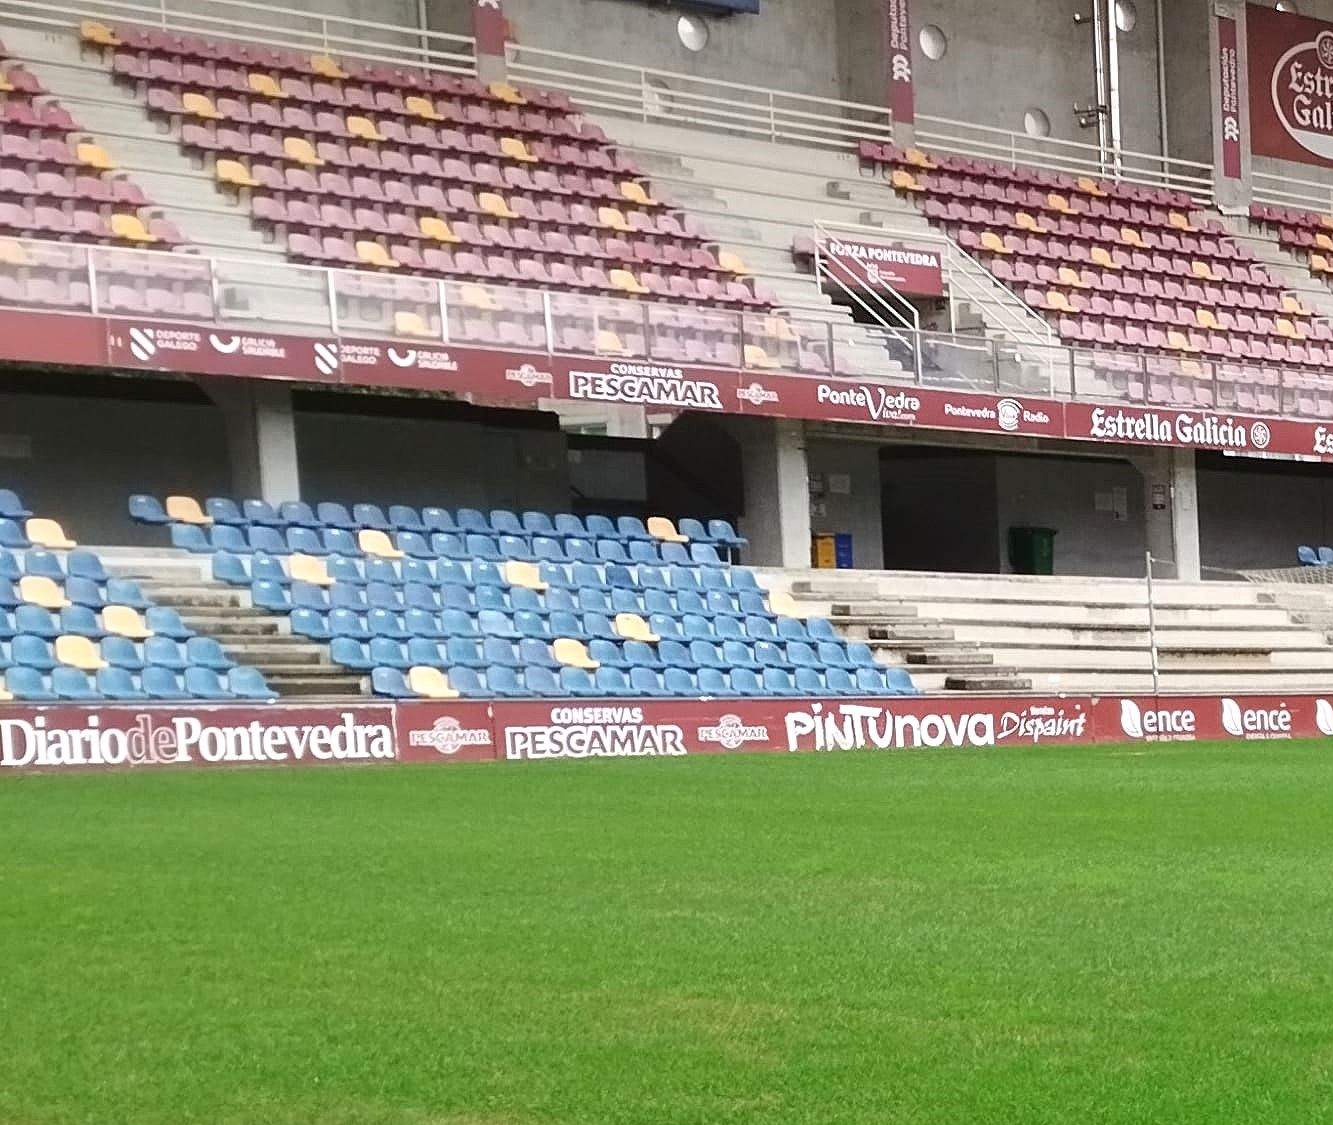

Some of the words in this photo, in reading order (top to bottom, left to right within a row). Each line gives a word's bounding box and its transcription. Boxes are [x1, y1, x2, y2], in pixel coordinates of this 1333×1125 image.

[610, 362, 683, 379] CONSERVAS
[569, 371, 724, 409] PESCAMAR
[944, 403, 996, 419] Pontevedra
[1023, 410, 1050, 424] Radio
[1090, 408, 1171, 443] Estrella
[1175, 417, 1247, 448] Galicia
[551, 707, 643, 724] CONSERVAS
[997, 704, 1087, 744] Dispaint
[1143, 708, 1196, 732] ence
[1243, 708, 1292, 732] ence
[0, 716, 127, 766] Diario
[126, 714, 177, 764] de
[172, 712, 394, 762] Pontevedra
[505, 726, 687, 760] PESCAMAR
